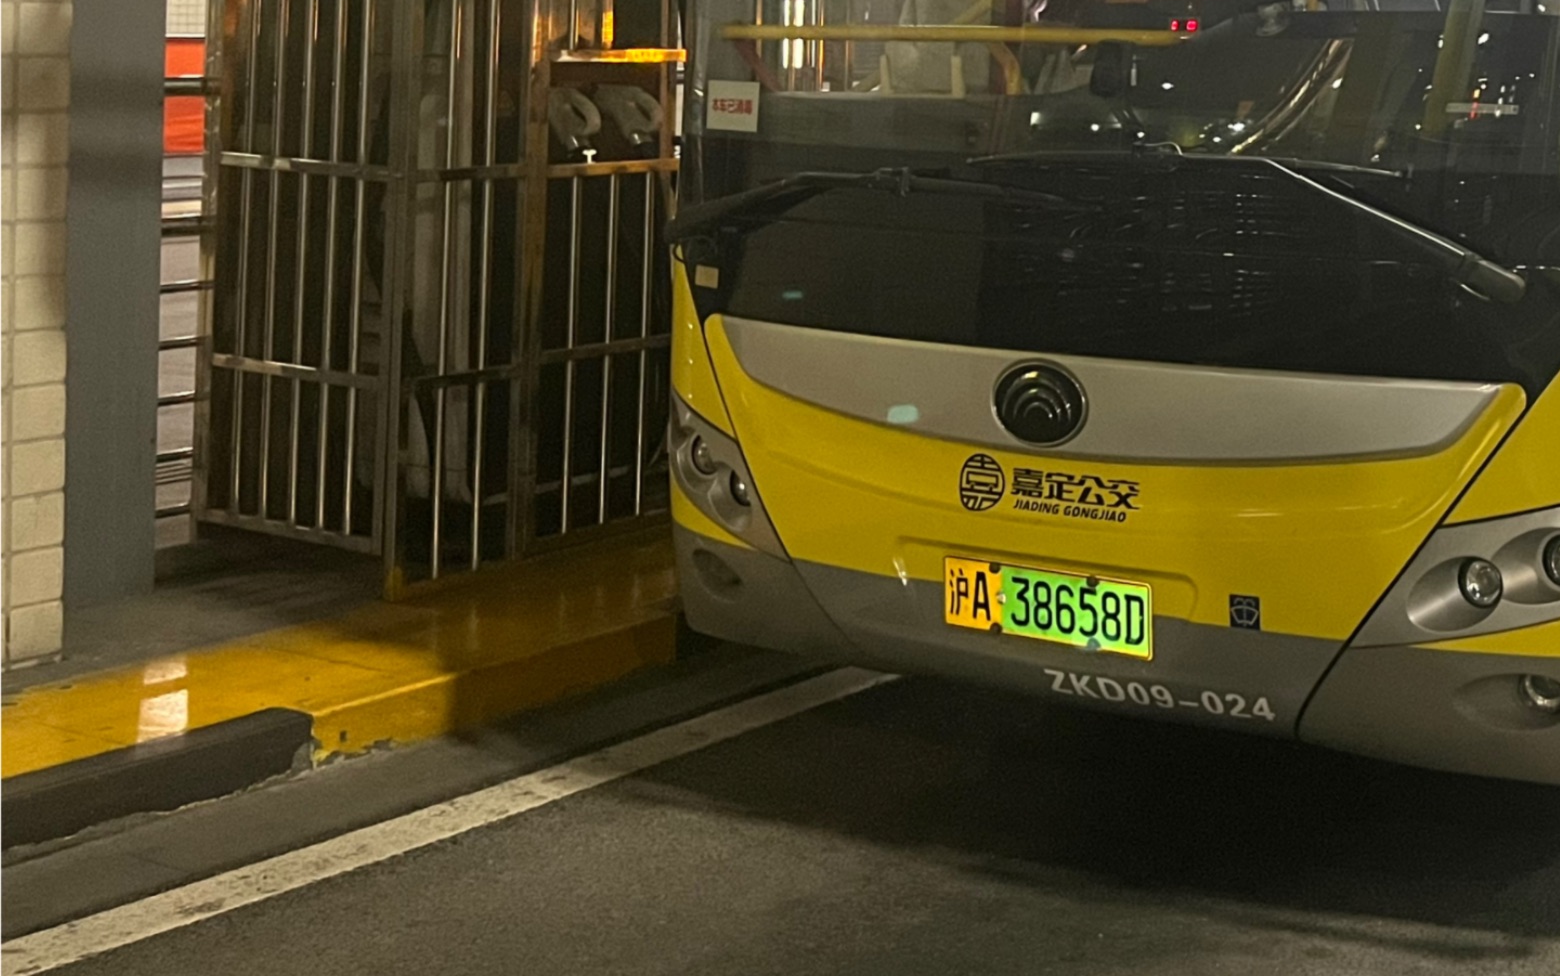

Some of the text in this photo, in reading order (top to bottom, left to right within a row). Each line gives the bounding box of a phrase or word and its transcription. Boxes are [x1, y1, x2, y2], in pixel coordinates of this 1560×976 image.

[1010, 468, 1141, 511] 嘉定公交
[1013, 499, 1127, 523] JIADING GONGJIAO
[1044, 667, 1276, 721] ZKD09-024
